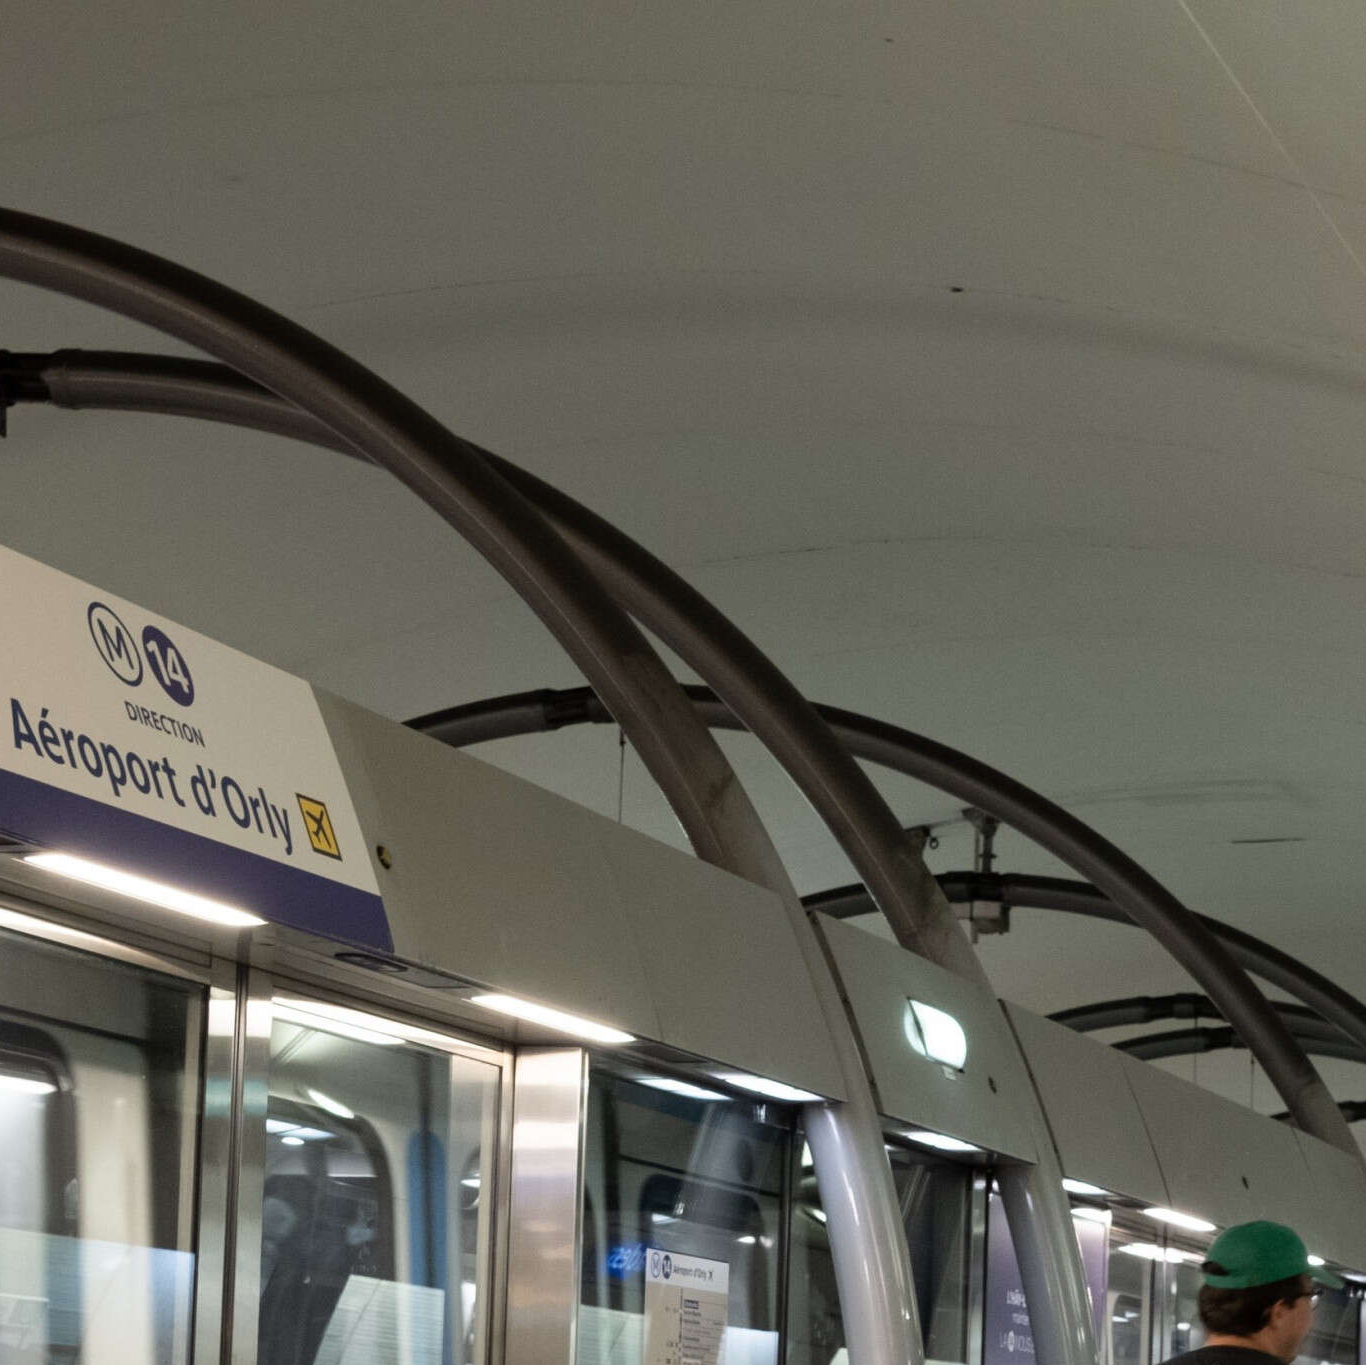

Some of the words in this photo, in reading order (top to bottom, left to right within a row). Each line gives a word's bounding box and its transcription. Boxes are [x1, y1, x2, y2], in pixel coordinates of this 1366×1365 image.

[145, 639, 190, 694] 14
[124, 700, 206, 748] DIRECTION
[10, 697, 186, 808] Aéroport
[189, 764, 294, 856] d'Orly
